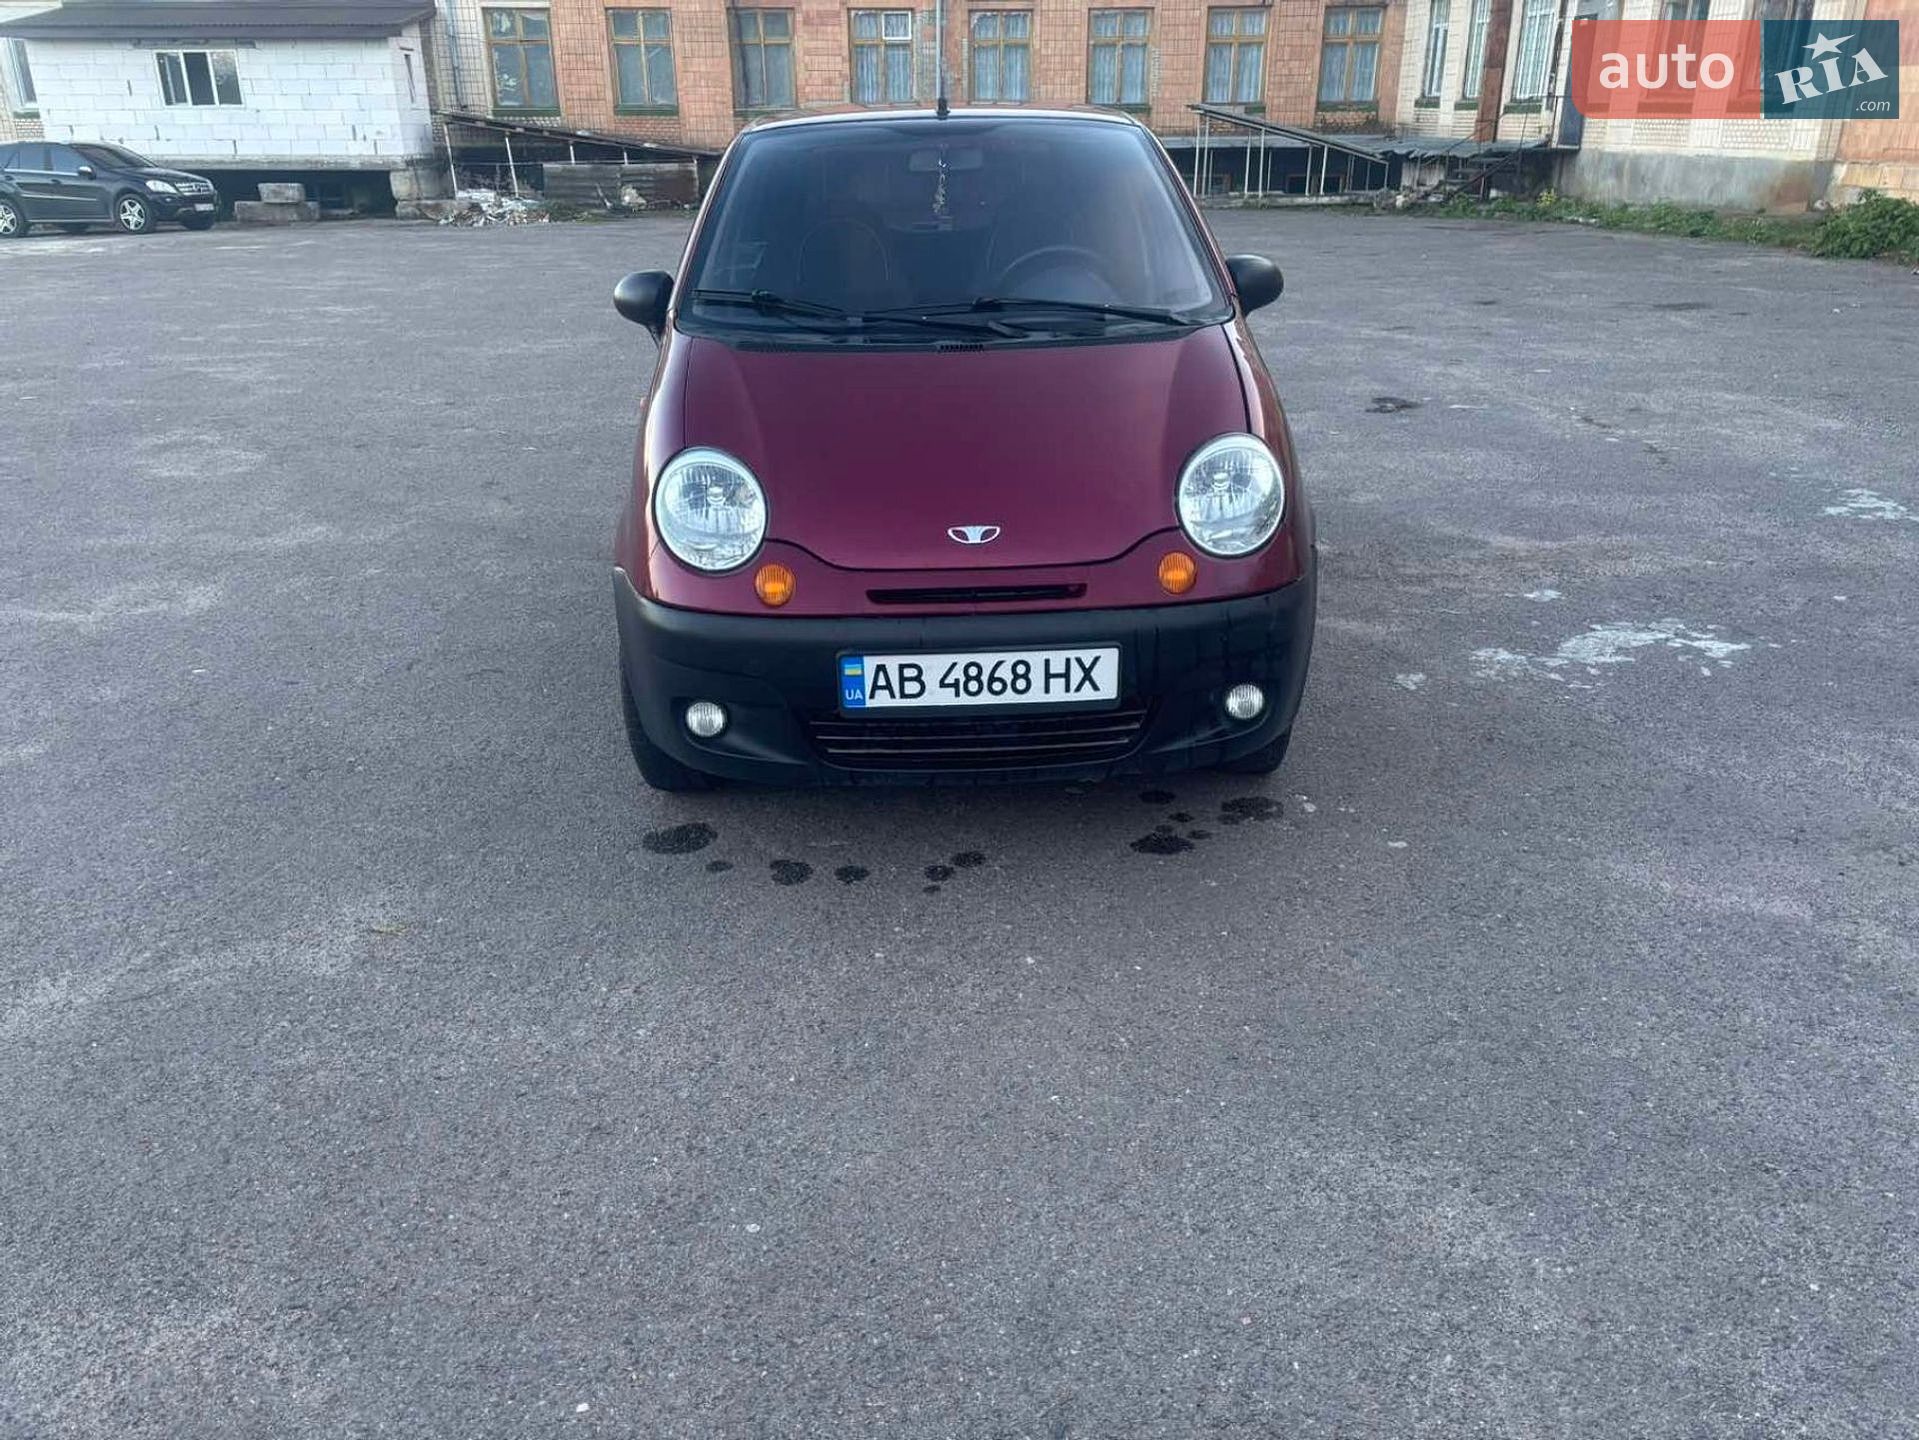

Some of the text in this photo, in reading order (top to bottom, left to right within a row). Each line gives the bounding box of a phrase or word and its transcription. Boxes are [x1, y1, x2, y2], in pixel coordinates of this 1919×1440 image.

[868, 655, 1101, 700] AB 4868 HX
[845, 689, 864, 701] UA
